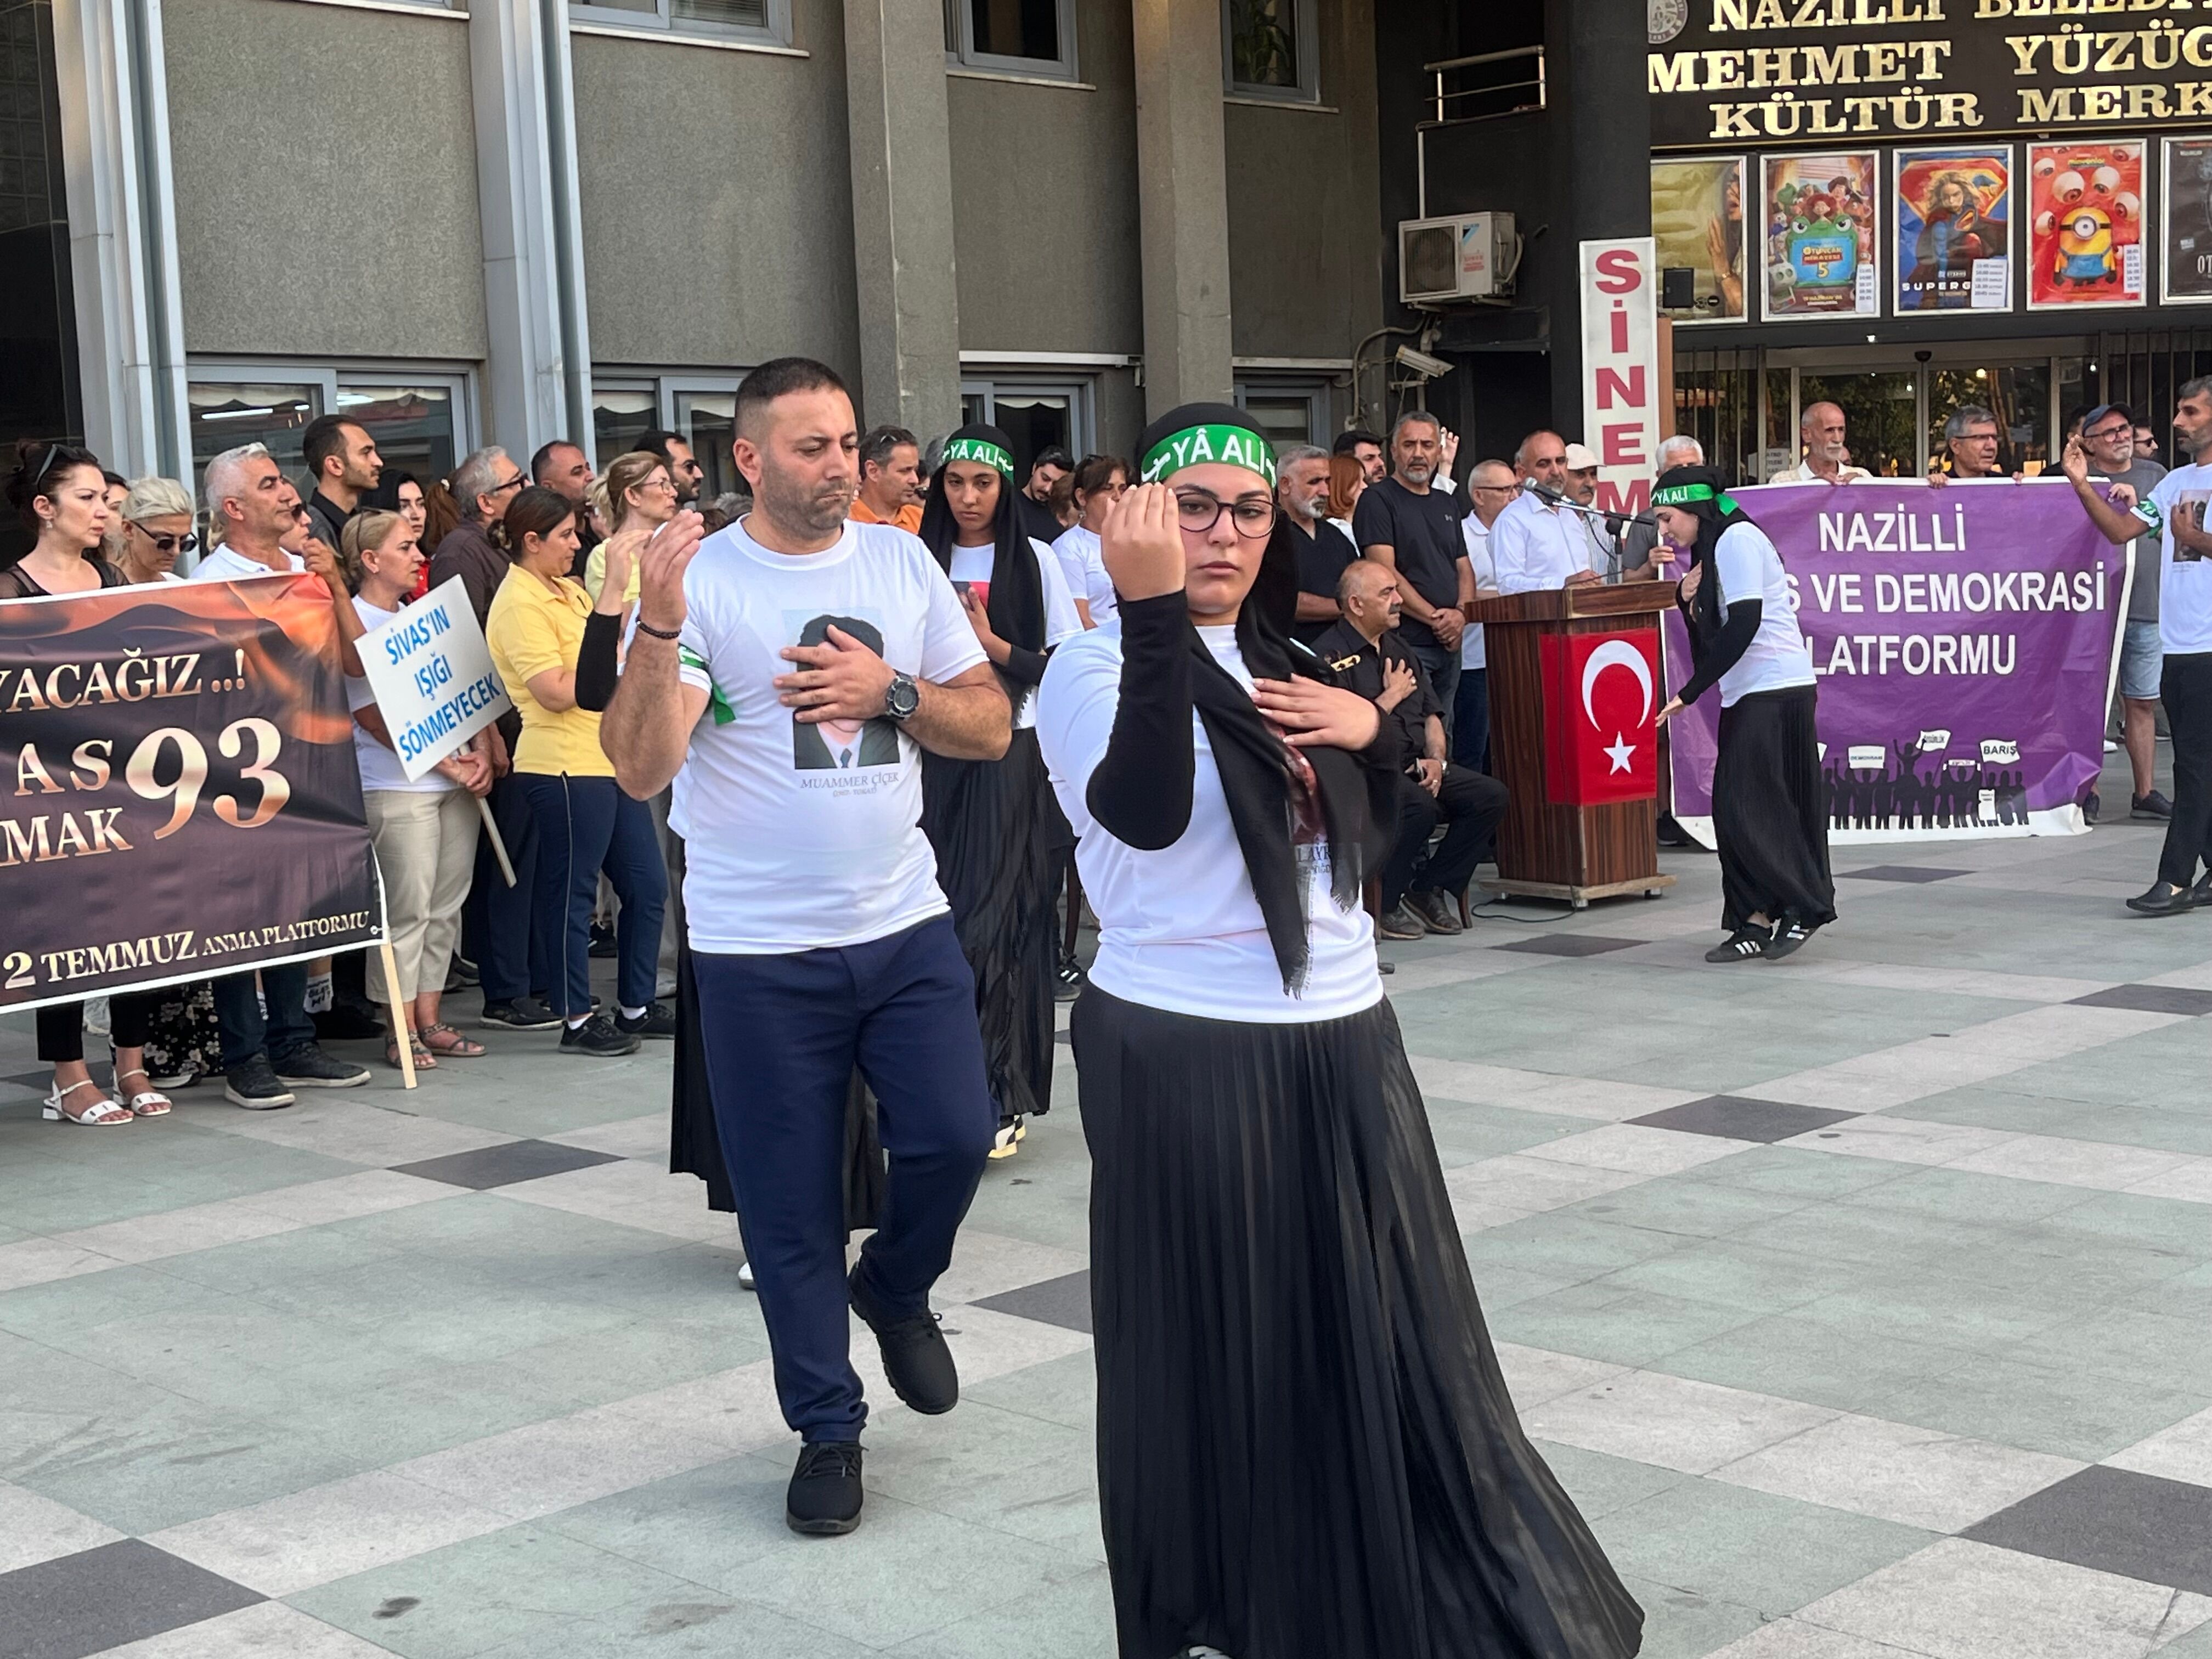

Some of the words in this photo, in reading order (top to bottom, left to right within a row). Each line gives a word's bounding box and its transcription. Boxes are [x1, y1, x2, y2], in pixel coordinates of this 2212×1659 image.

[1648, 41, 1951, 93] MEHMET
[1709, 86, 1984, 138] KÜLTÜR
[2017, 81, 2212, 123] MERK
[1817, 262, 1829, 278] 5
[1902, 281, 1971, 291] SUPERG
[1595, 250, 1650, 520] SİNEM
[1819, 503, 1966, 552] NAZİLLİ
[1810, 573, 1864, 613] VE
[1876, 561, 2106, 613] DEMOKRASİ
[1805, 634, 2017, 676] LATFORMU
[399, 672, 501, 762] SÖNMEYECEK
[125, 717, 291, 840] 93
[800, 776, 868, 789] MUAMMER
[3, 952, 36, 990] 2
[40, 931, 198, 982] TEMMUZ
[202, 930, 261, 956] ANMA
[262, 911, 370, 946] PLATFORMU
